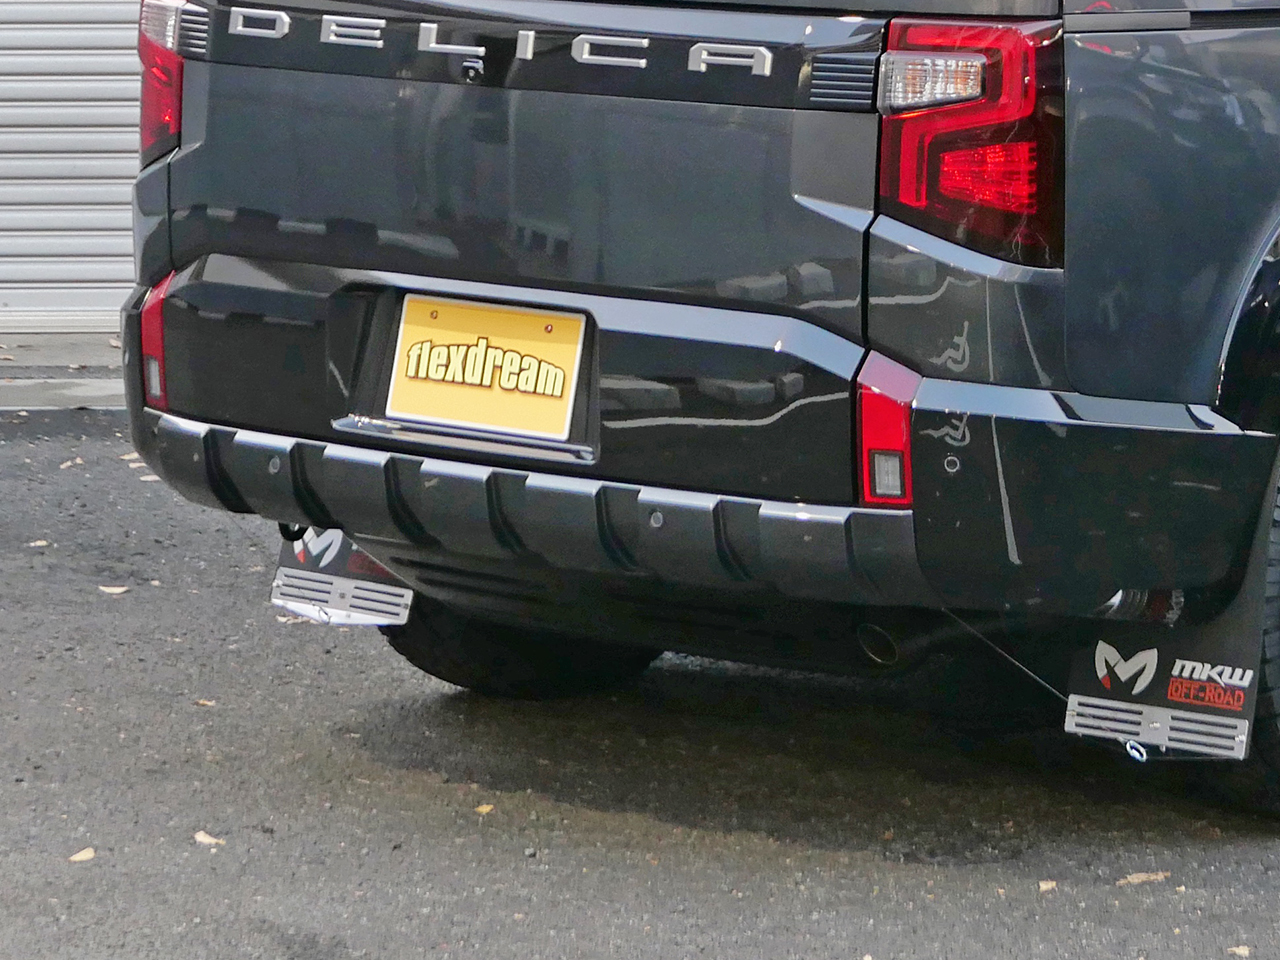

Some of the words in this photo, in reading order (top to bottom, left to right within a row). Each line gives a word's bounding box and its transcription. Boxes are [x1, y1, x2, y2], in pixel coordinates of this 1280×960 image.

[228, 6, 774, 77] DELICA
[406, 336, 566, 399] flexdream
[1168, 677, 1245, 711] OFF-ROAD
